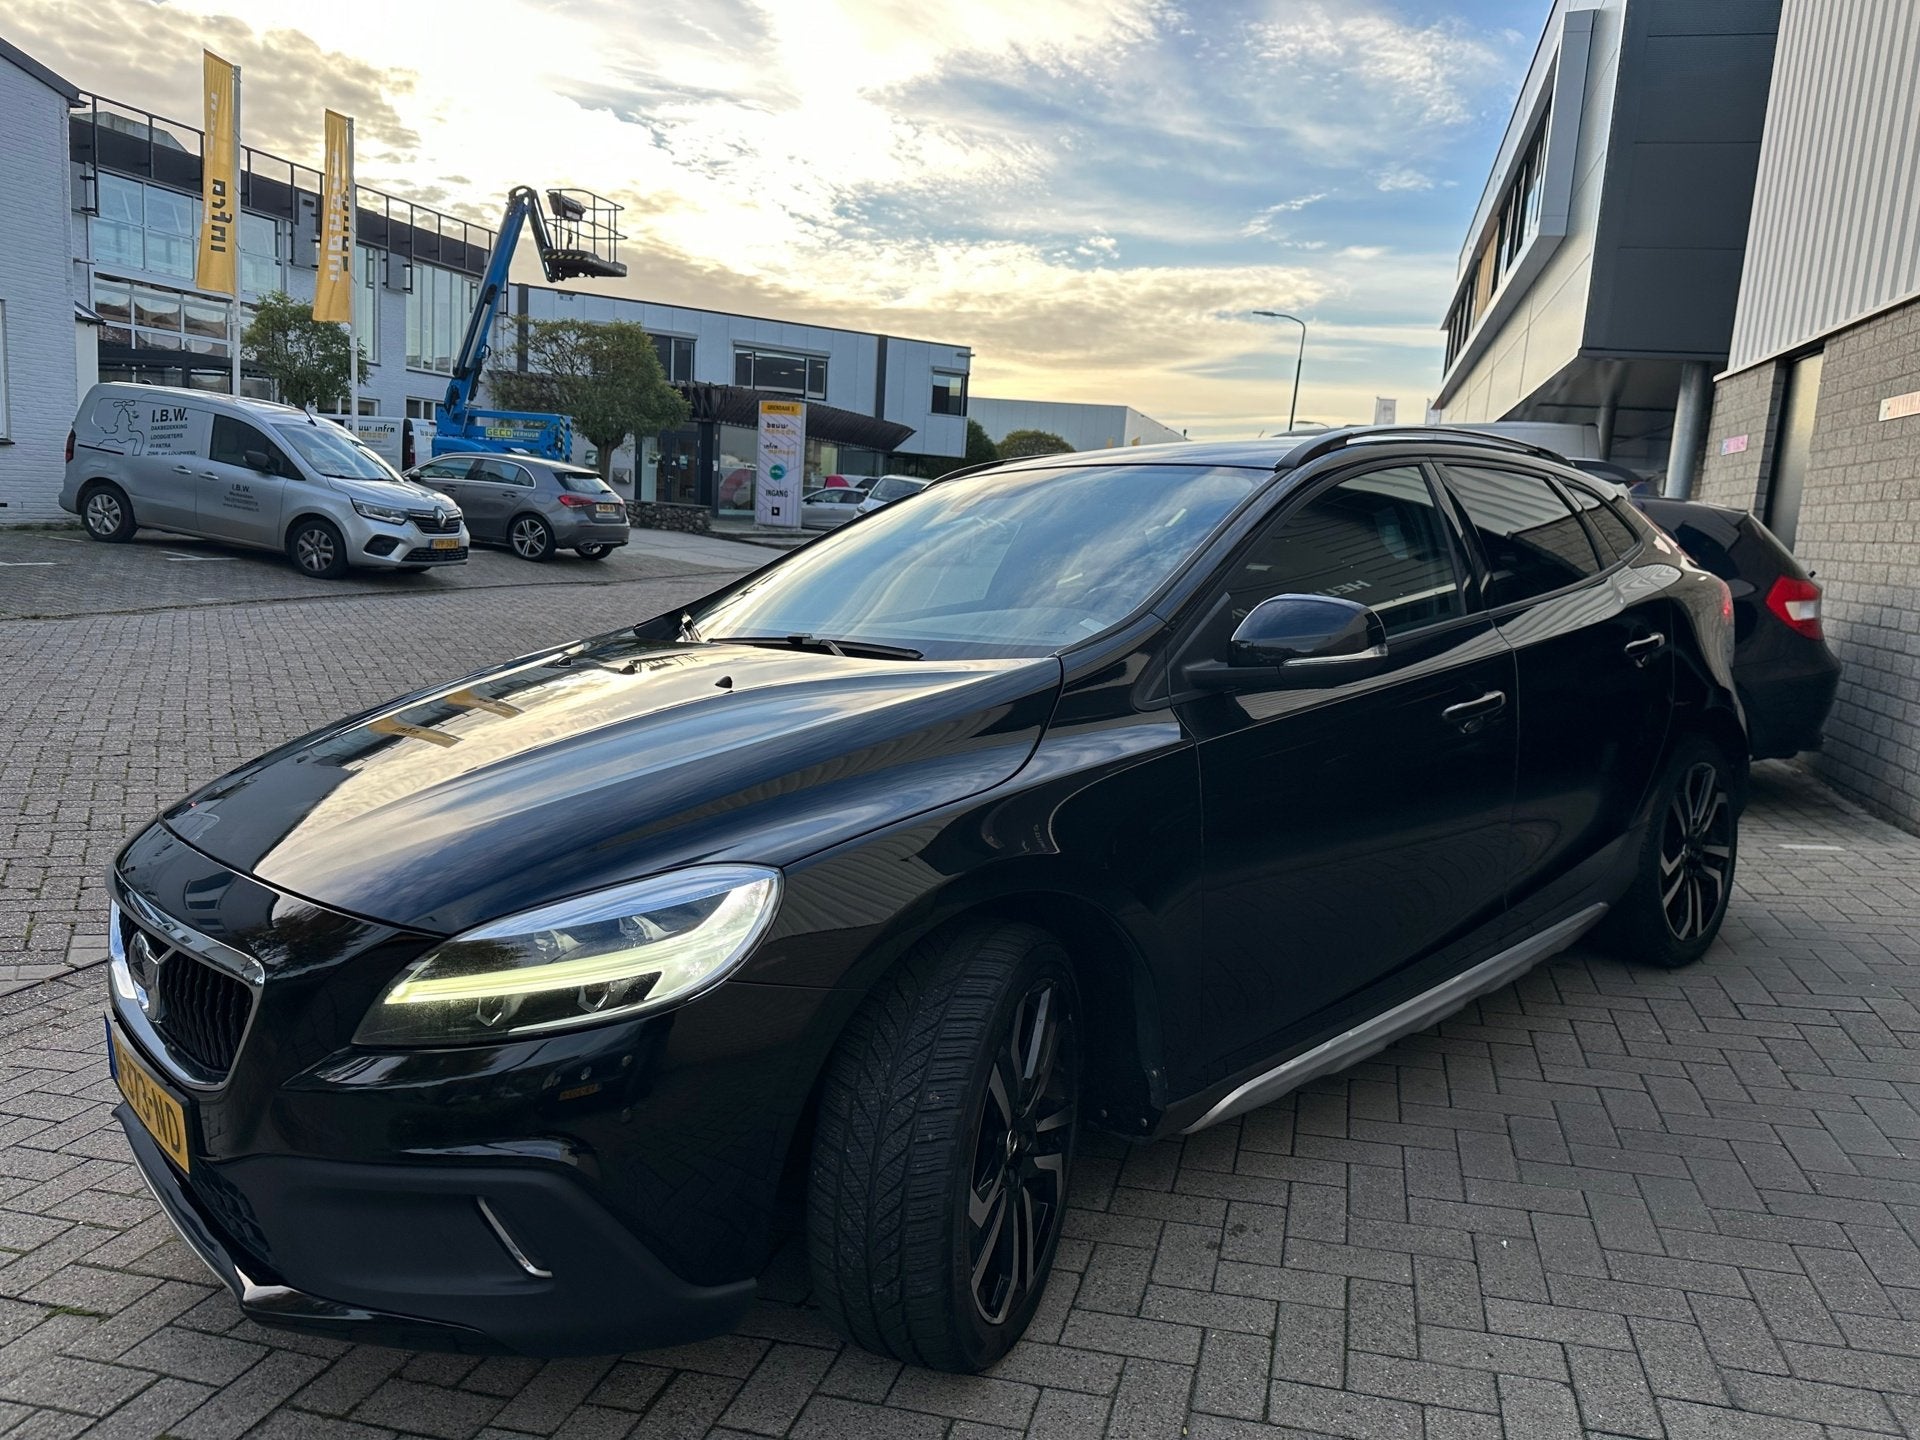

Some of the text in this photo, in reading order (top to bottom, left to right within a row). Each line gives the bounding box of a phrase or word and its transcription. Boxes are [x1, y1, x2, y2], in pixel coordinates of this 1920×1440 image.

[151, 408, 188, 423] I.B.W.
[348, 423, 372, 431] buw
[486, 428, 513, 437] GECO
[765, 489, 789, 498] INGANG
